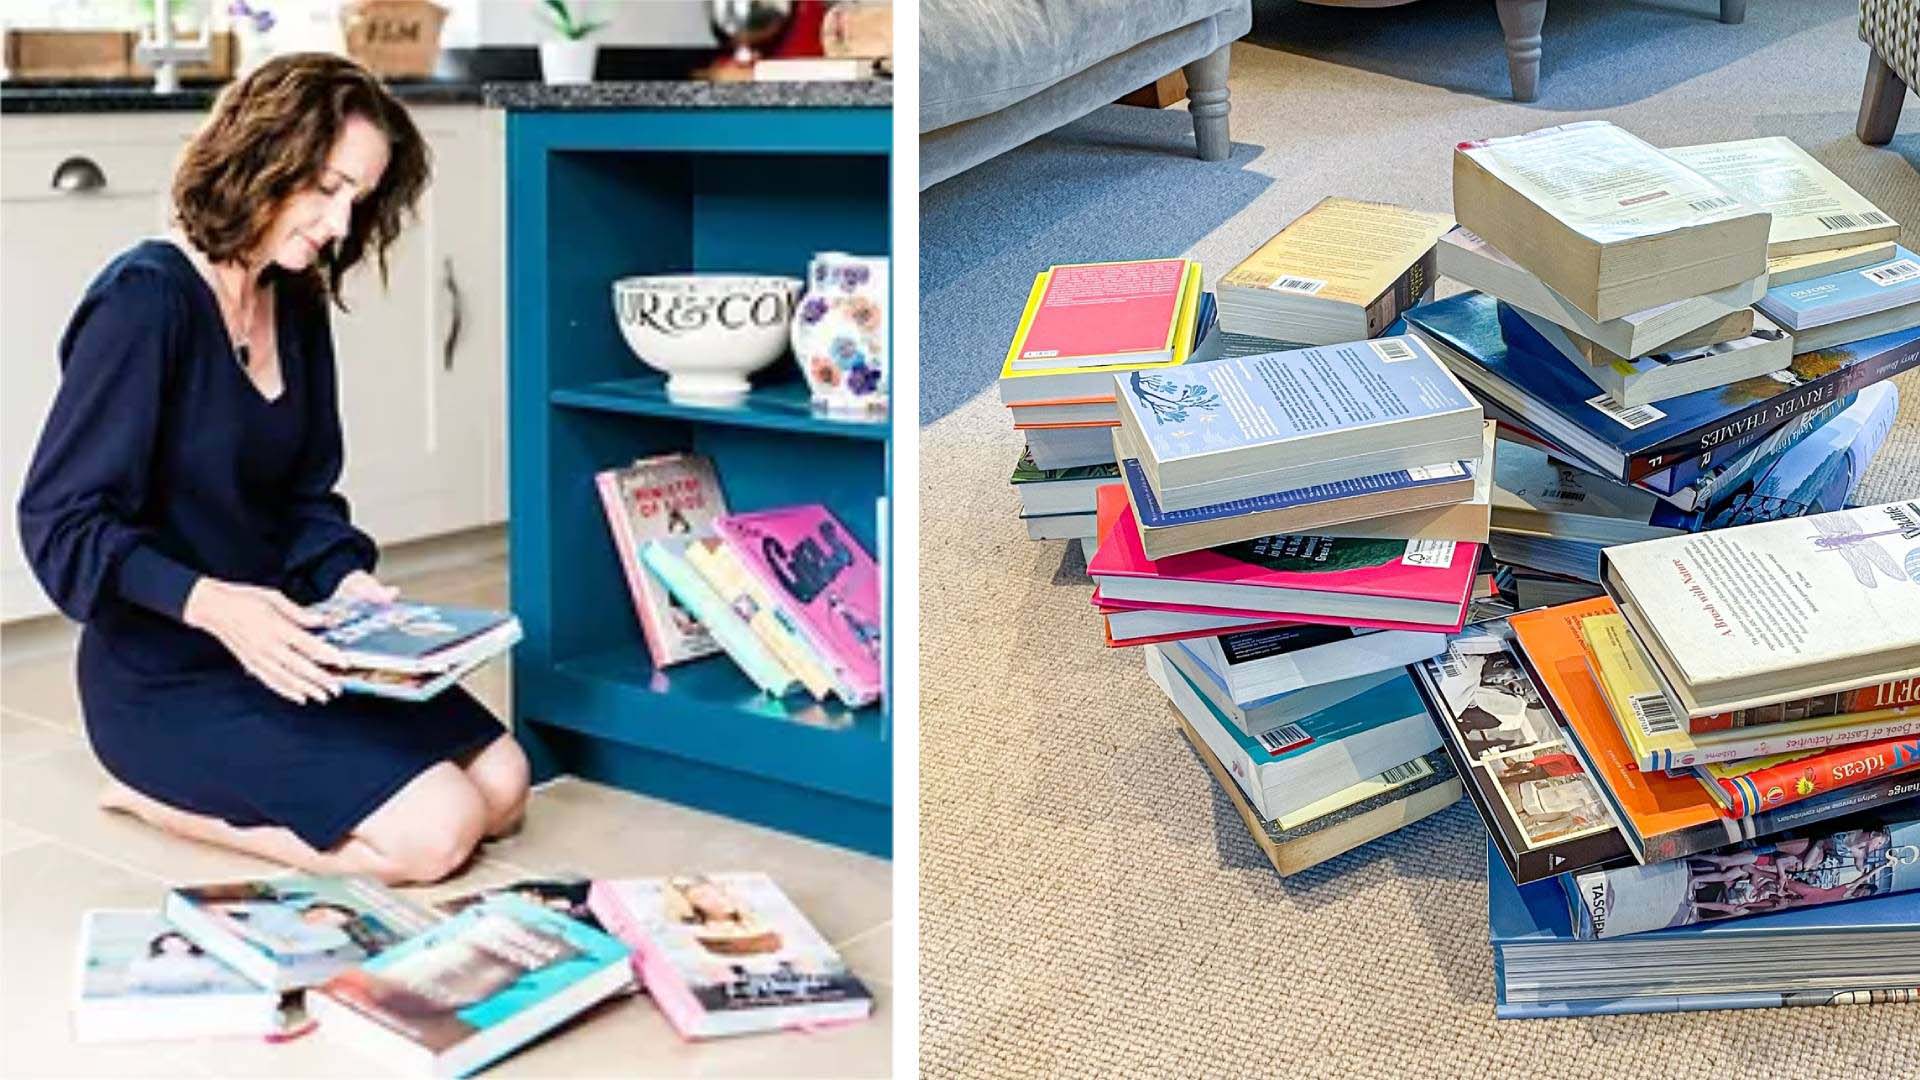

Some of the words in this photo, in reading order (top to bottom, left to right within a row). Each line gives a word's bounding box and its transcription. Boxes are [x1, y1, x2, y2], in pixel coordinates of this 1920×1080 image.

[1775, 386, 1824, 418] RIVER
[1701, 414, 1770, 449] THAMES
[1672, 558, 1696, 584] Nature
[1689, 585, 1709, 603] with
[1703, 603, 1729, 629] Brush
[1837, 729, 1869, 742] Easter
[1871, 726, 1884, 739] of
[1886, 723, 1912, 736] Book
[1786, 733, 1836, 748] Activities
[1832, 753, 1885, 780] ideas
[1888, 781, 1920, 798] hange
[1816, 804, 1831, 814] with
